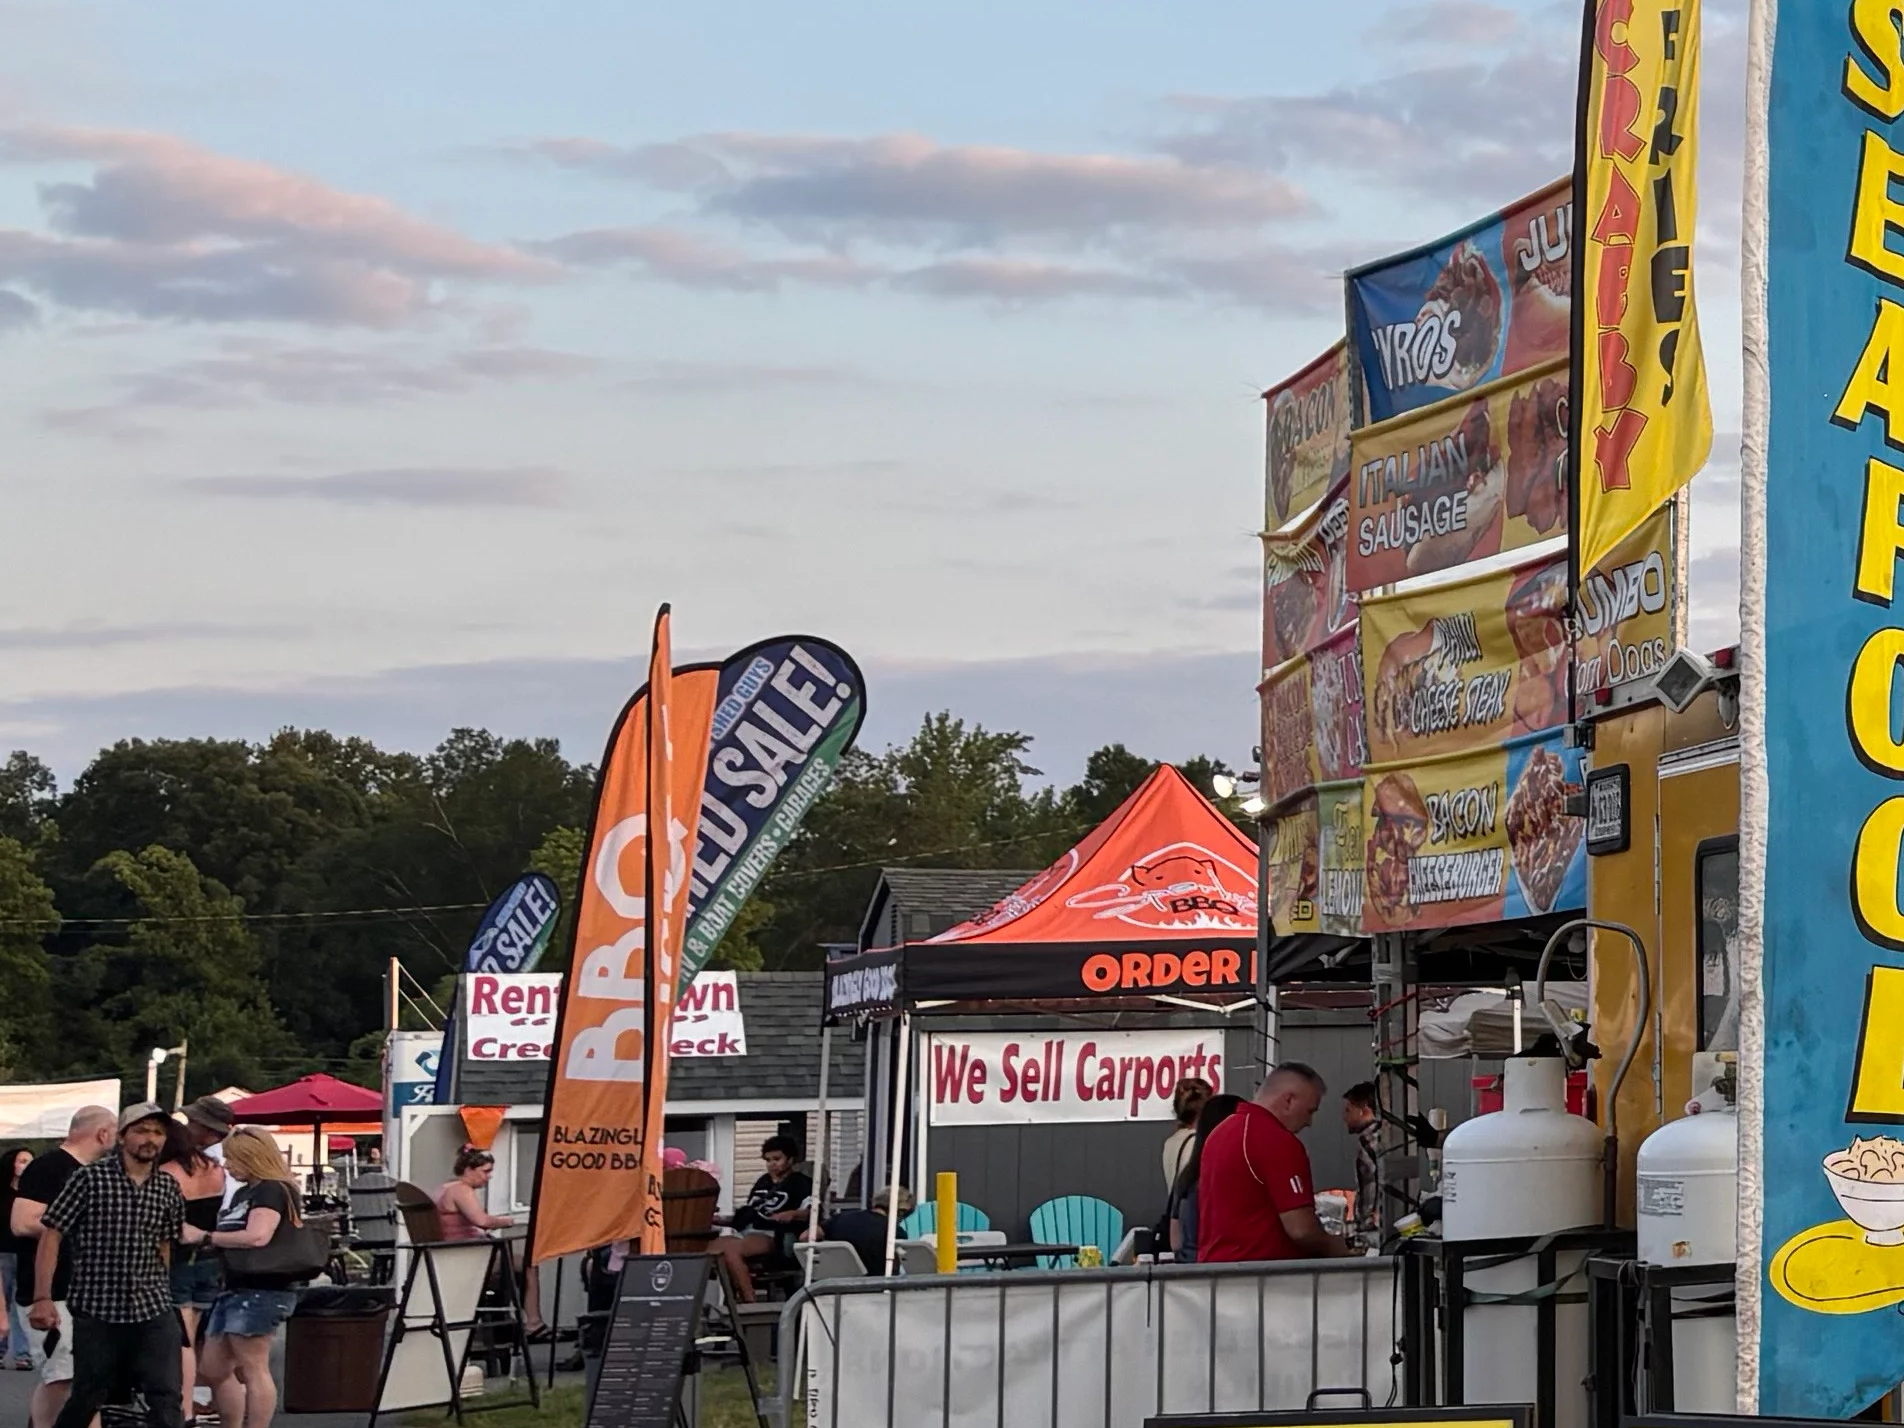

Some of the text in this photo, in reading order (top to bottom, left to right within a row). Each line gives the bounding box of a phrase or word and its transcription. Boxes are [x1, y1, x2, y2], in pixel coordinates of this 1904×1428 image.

[1518, 203, 1572, 271] JU
[1372, 309, 1462, 392] YROS
[1357, 432, 1468, 509] ITALIAN
[1358, 490, 1469, 558] SAUSAGE
[738, 656, 773, 704] GUYS
[712, 644, 852, 810] SALE!
[697, 894, 737, 939] BOAT
[726, 832, 778, 895] COVERS
[775, 756, 831, 832] GARAGES
[1425, 783, 1499, 845] BACON
[1169, 895, 1240, 916] BBQ
[675, 982, 735, 1012] wn
[934, 1039, 1223, 1117] We Sell Carports
[550, 1151, 606, 1171] GOOD
[552, 1125, 644, 1147] BLAZINGL
